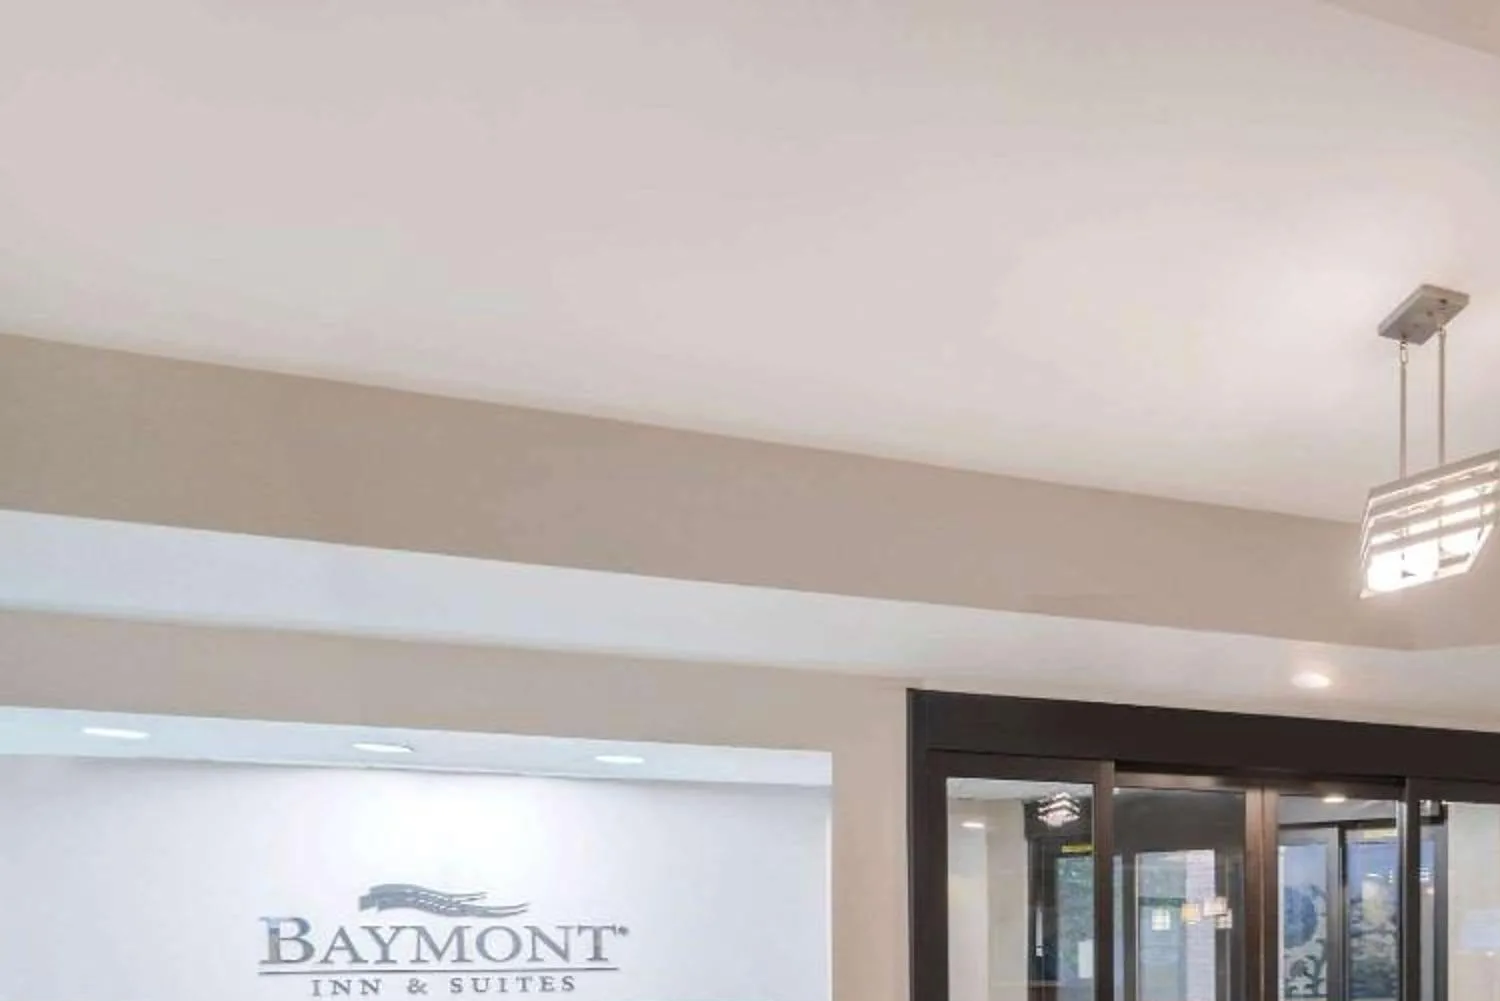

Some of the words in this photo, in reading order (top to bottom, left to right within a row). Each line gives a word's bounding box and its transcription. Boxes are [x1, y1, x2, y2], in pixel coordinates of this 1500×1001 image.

[258, 914, 617, 966] BAYMONT
[311, 976, 383, 998] INN
[406, 976, 430, 996] &
[449, 974, 578, 995] SUITES
